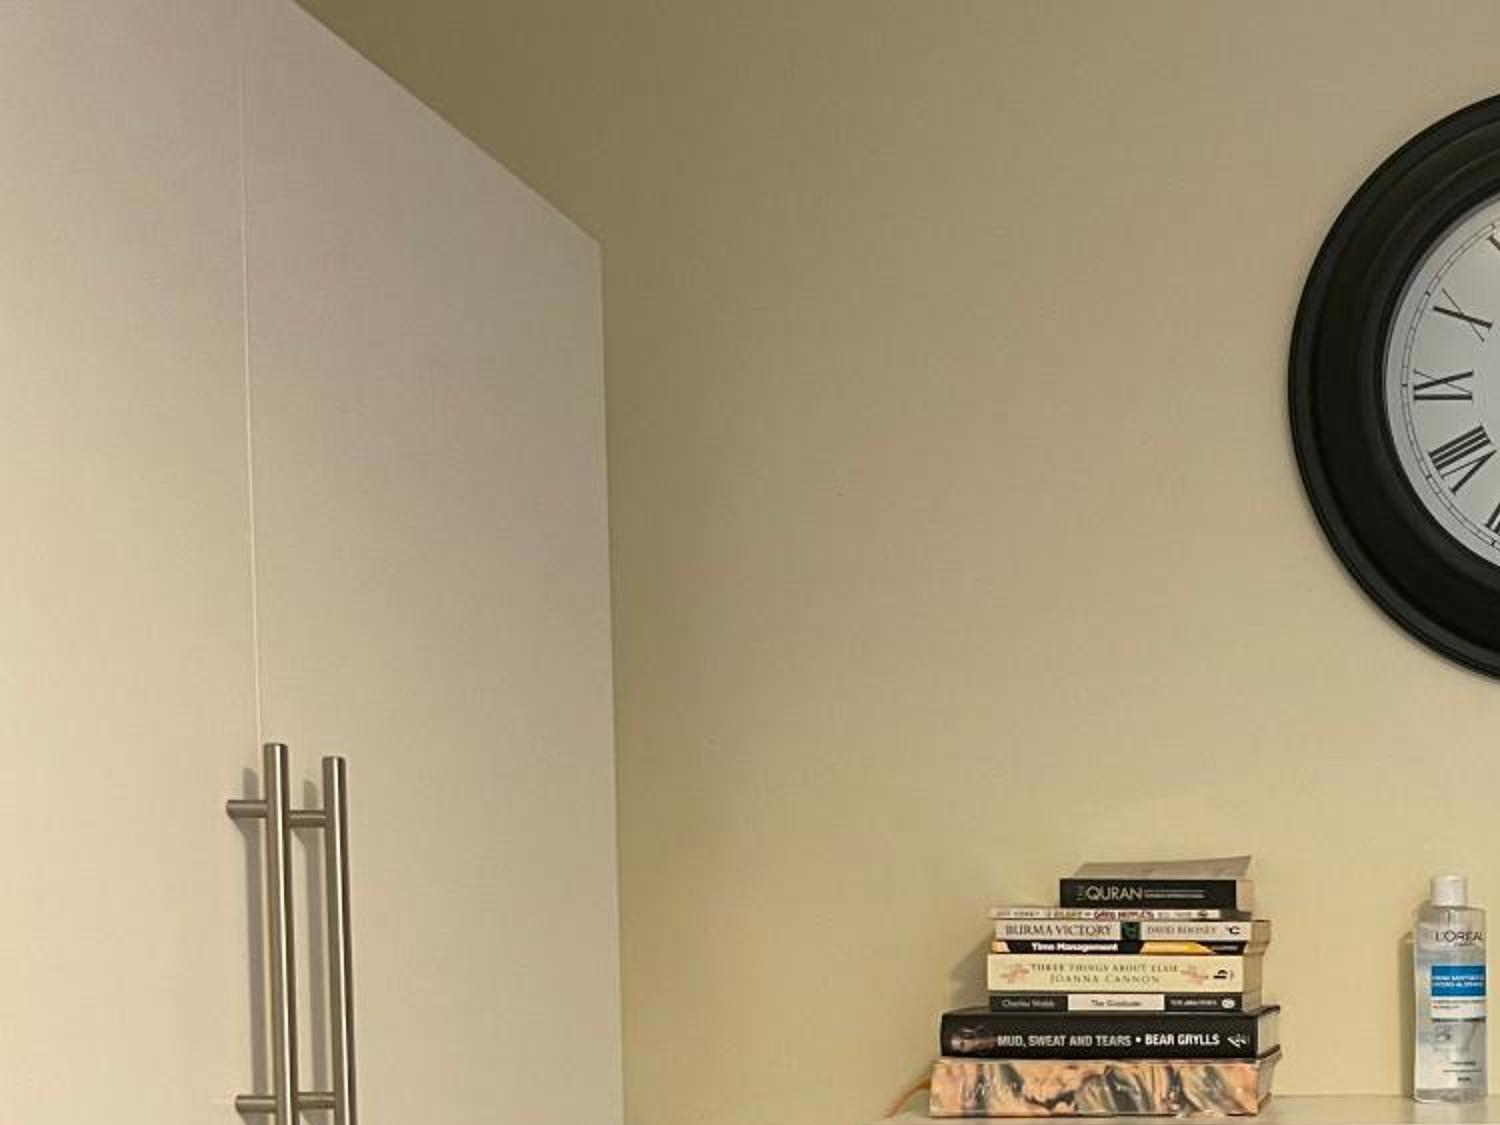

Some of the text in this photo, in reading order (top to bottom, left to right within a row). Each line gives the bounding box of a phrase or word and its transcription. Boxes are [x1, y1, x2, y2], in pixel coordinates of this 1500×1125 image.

[1433, 287, 1493, 343] X
[1413, 369, 1473, 402] IX
[1428, 422, 1497, 494] VIII
[1085, 885, 1143, 901] QURAN
[1005, 924, 1113, 937] BURMA VICTORY
[1031, 942, 1119, 953] Time Management
[1031, 963, 1064, 973] THREE
[1069, 963, 1110, 973] THINGS
[1111, 963, 1147, 973] ABOUT
[1049, 974, 1160, 984] JOANNA CANNON
[997, 1032, 1221, 1048] MUD, SWEAT AND TEARS BEAR GRYLLS
